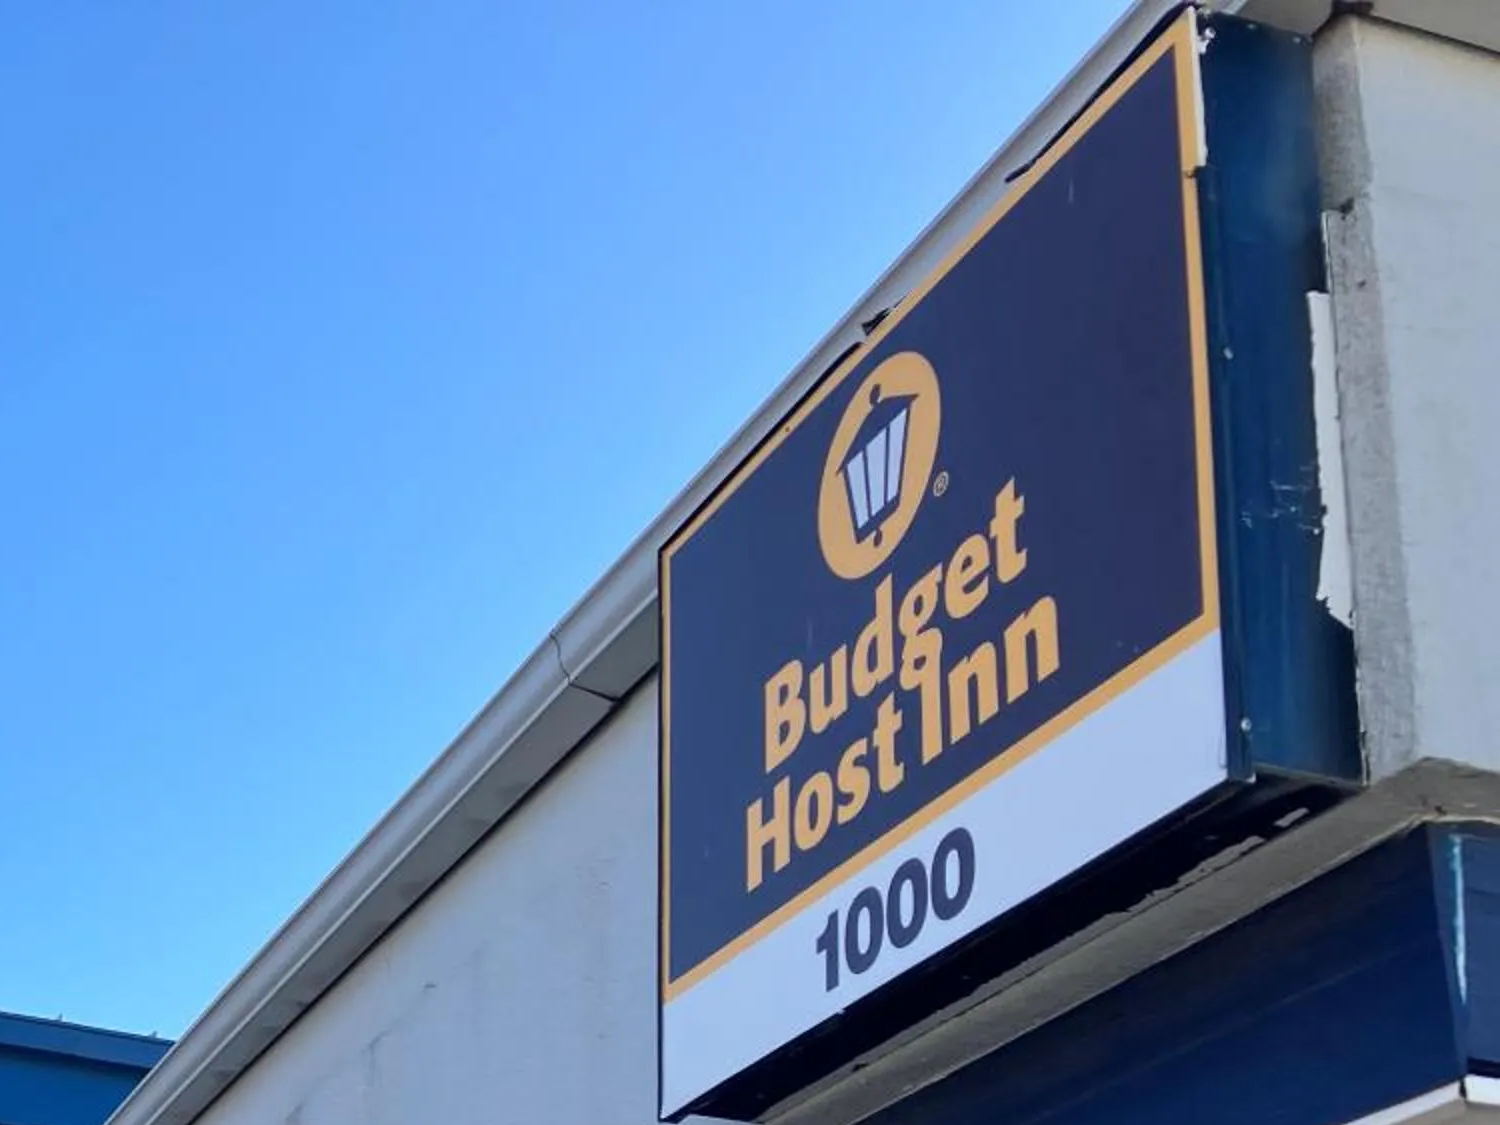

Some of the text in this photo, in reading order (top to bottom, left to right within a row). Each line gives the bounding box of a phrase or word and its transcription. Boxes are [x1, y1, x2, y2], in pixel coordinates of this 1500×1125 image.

[745, 595, 1061, 894] Host Inn
[763, 475, 1028, 775] Budget
[815, 826, 977, 993] 1000
